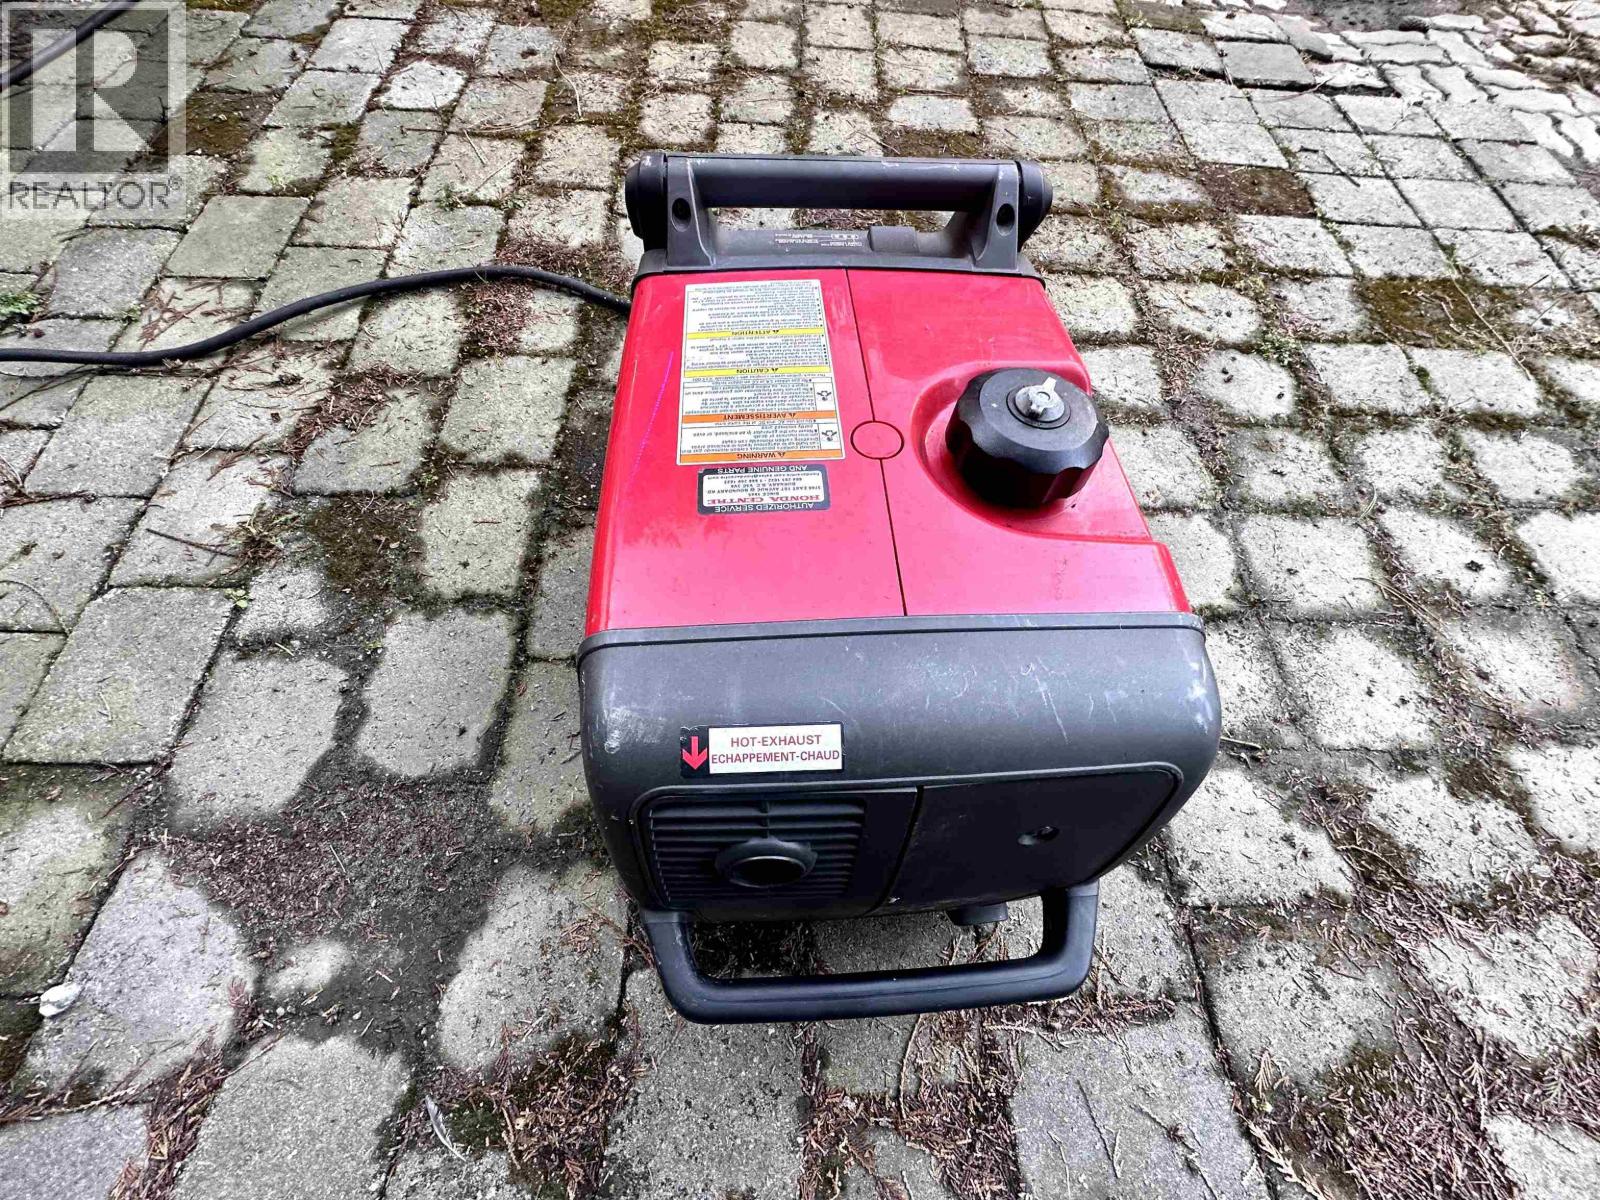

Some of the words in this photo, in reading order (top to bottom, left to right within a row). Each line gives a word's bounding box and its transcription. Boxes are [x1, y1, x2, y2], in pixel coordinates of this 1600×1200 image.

[769, 495, 820, 503] HONDA
[730, 735, 821, 748] HOT-EXHAUST
[712, 750, 840, 764] ECHAPPEMENT-CHAUD
